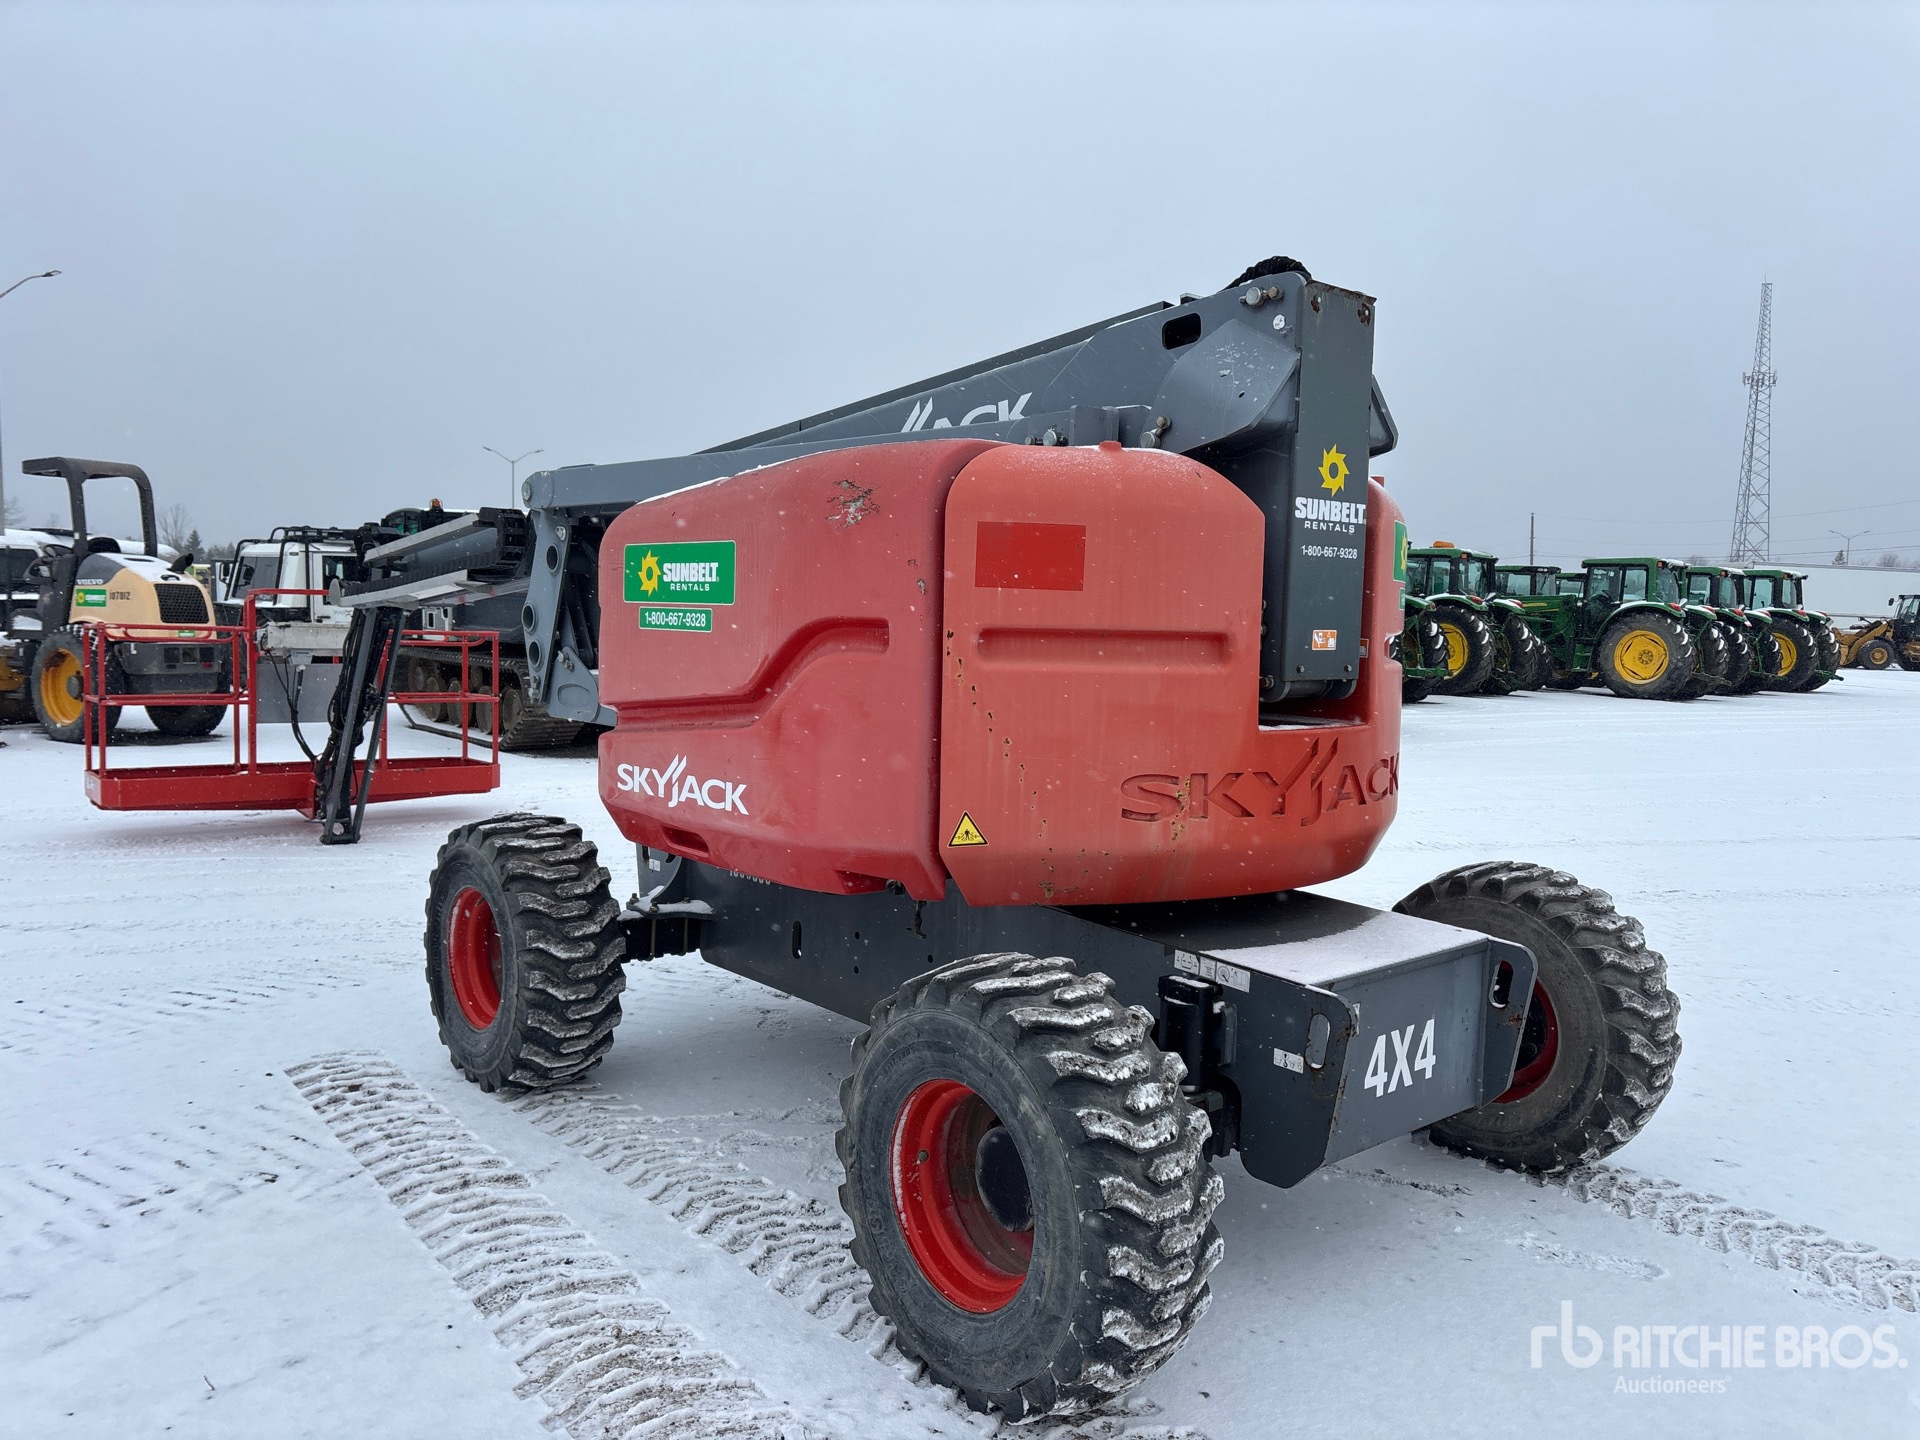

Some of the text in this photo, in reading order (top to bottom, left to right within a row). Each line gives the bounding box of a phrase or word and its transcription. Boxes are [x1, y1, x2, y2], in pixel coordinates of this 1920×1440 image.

[1295, 496, 1366, 525] SUNBELT
[1304, 521, 1355, 533] RENTALS
[1301, 545, 1358, 559] 1-800-667-9328
[662, 562, 719, 582] SUNBELT
[670, 583, 710, 592] RENTALS
[645, 611, 706, 627] 1-800-667-9328
[616, 753, 750, 816] SKYJACK
[1120, 736, 1400, 827] SKYJACK
[1363, 1018, 1436, 1098] 4X4
